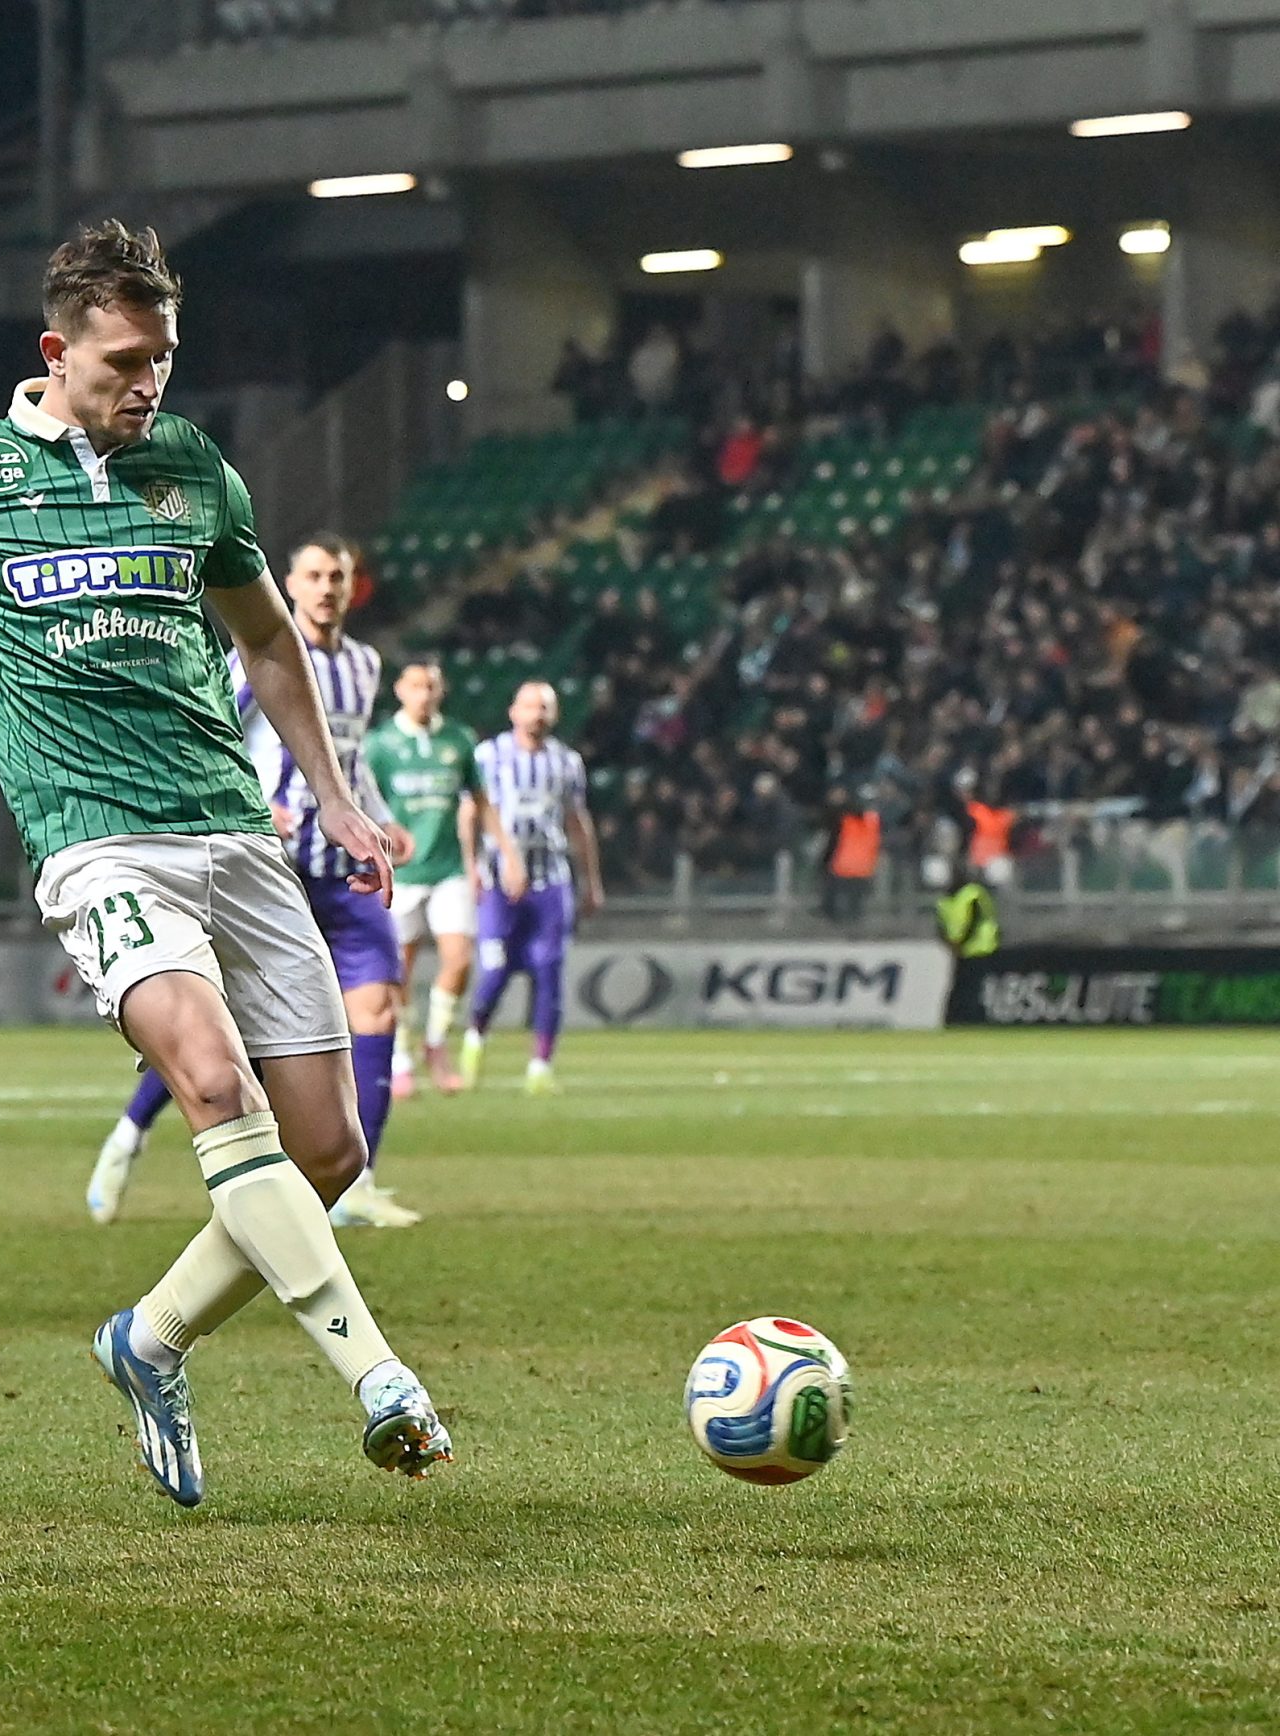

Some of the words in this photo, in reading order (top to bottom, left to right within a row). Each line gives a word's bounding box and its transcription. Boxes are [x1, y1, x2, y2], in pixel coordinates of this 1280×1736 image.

[45, 607, 179, 659] Kukkonia
[86, 891, 154, 977] 23
[701, 958, 904, 1006] KGM
